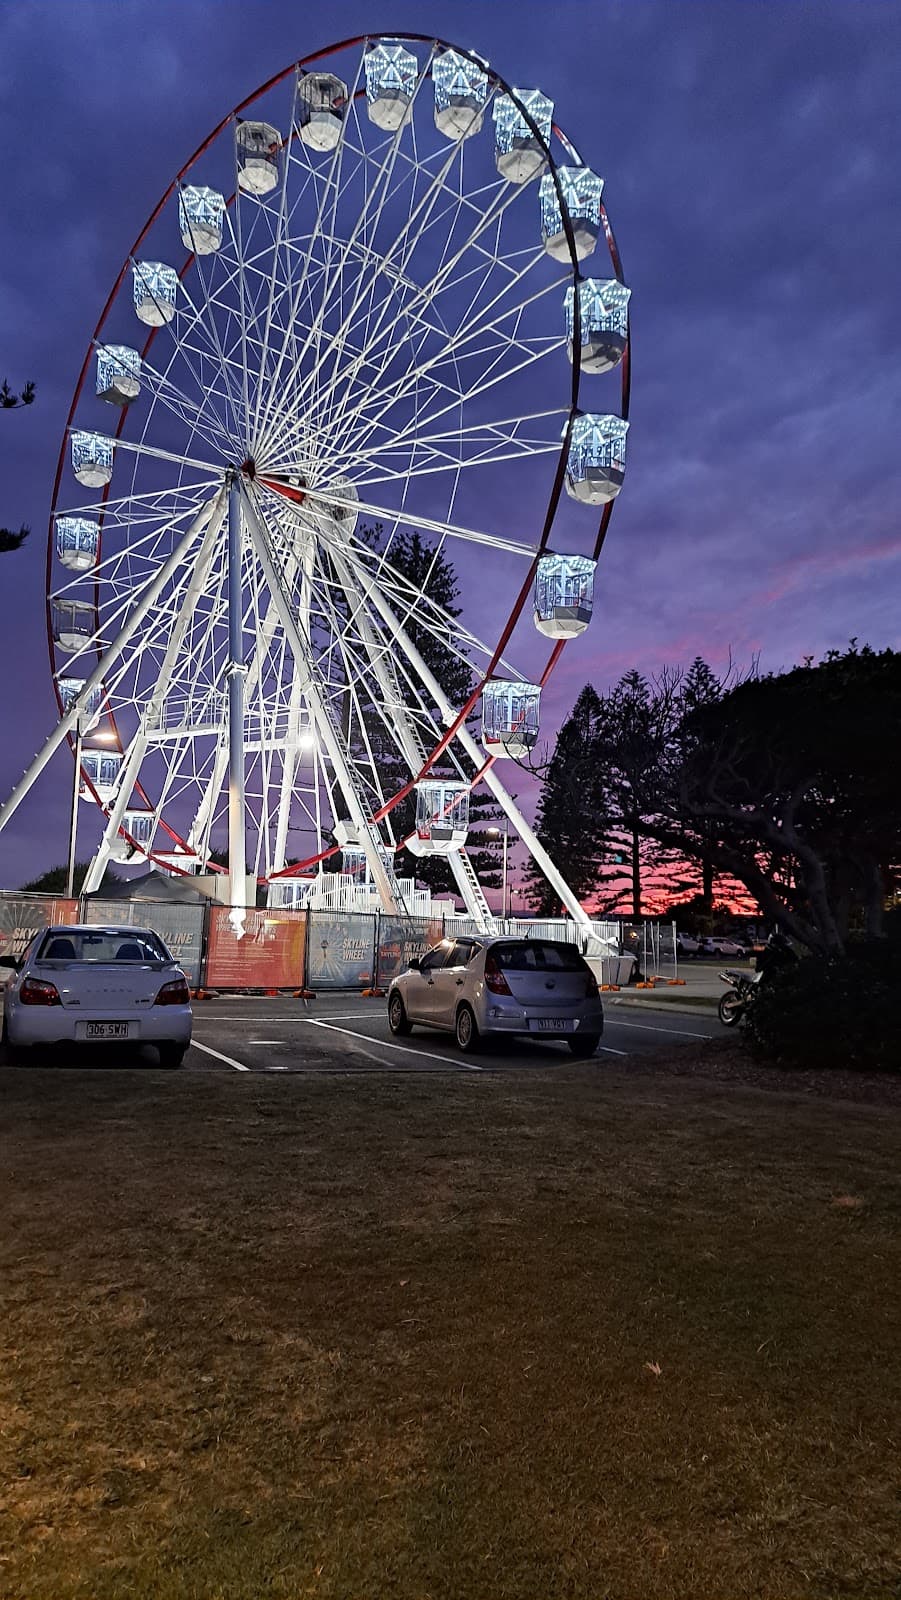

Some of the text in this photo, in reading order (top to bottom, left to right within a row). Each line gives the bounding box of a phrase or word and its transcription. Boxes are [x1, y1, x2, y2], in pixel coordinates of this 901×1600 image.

[342, 937, 371, 949] SKYLINE
[342, 949, 366, 960] WHEEL
[88, 1024, 127, 1034] 306 SWH
